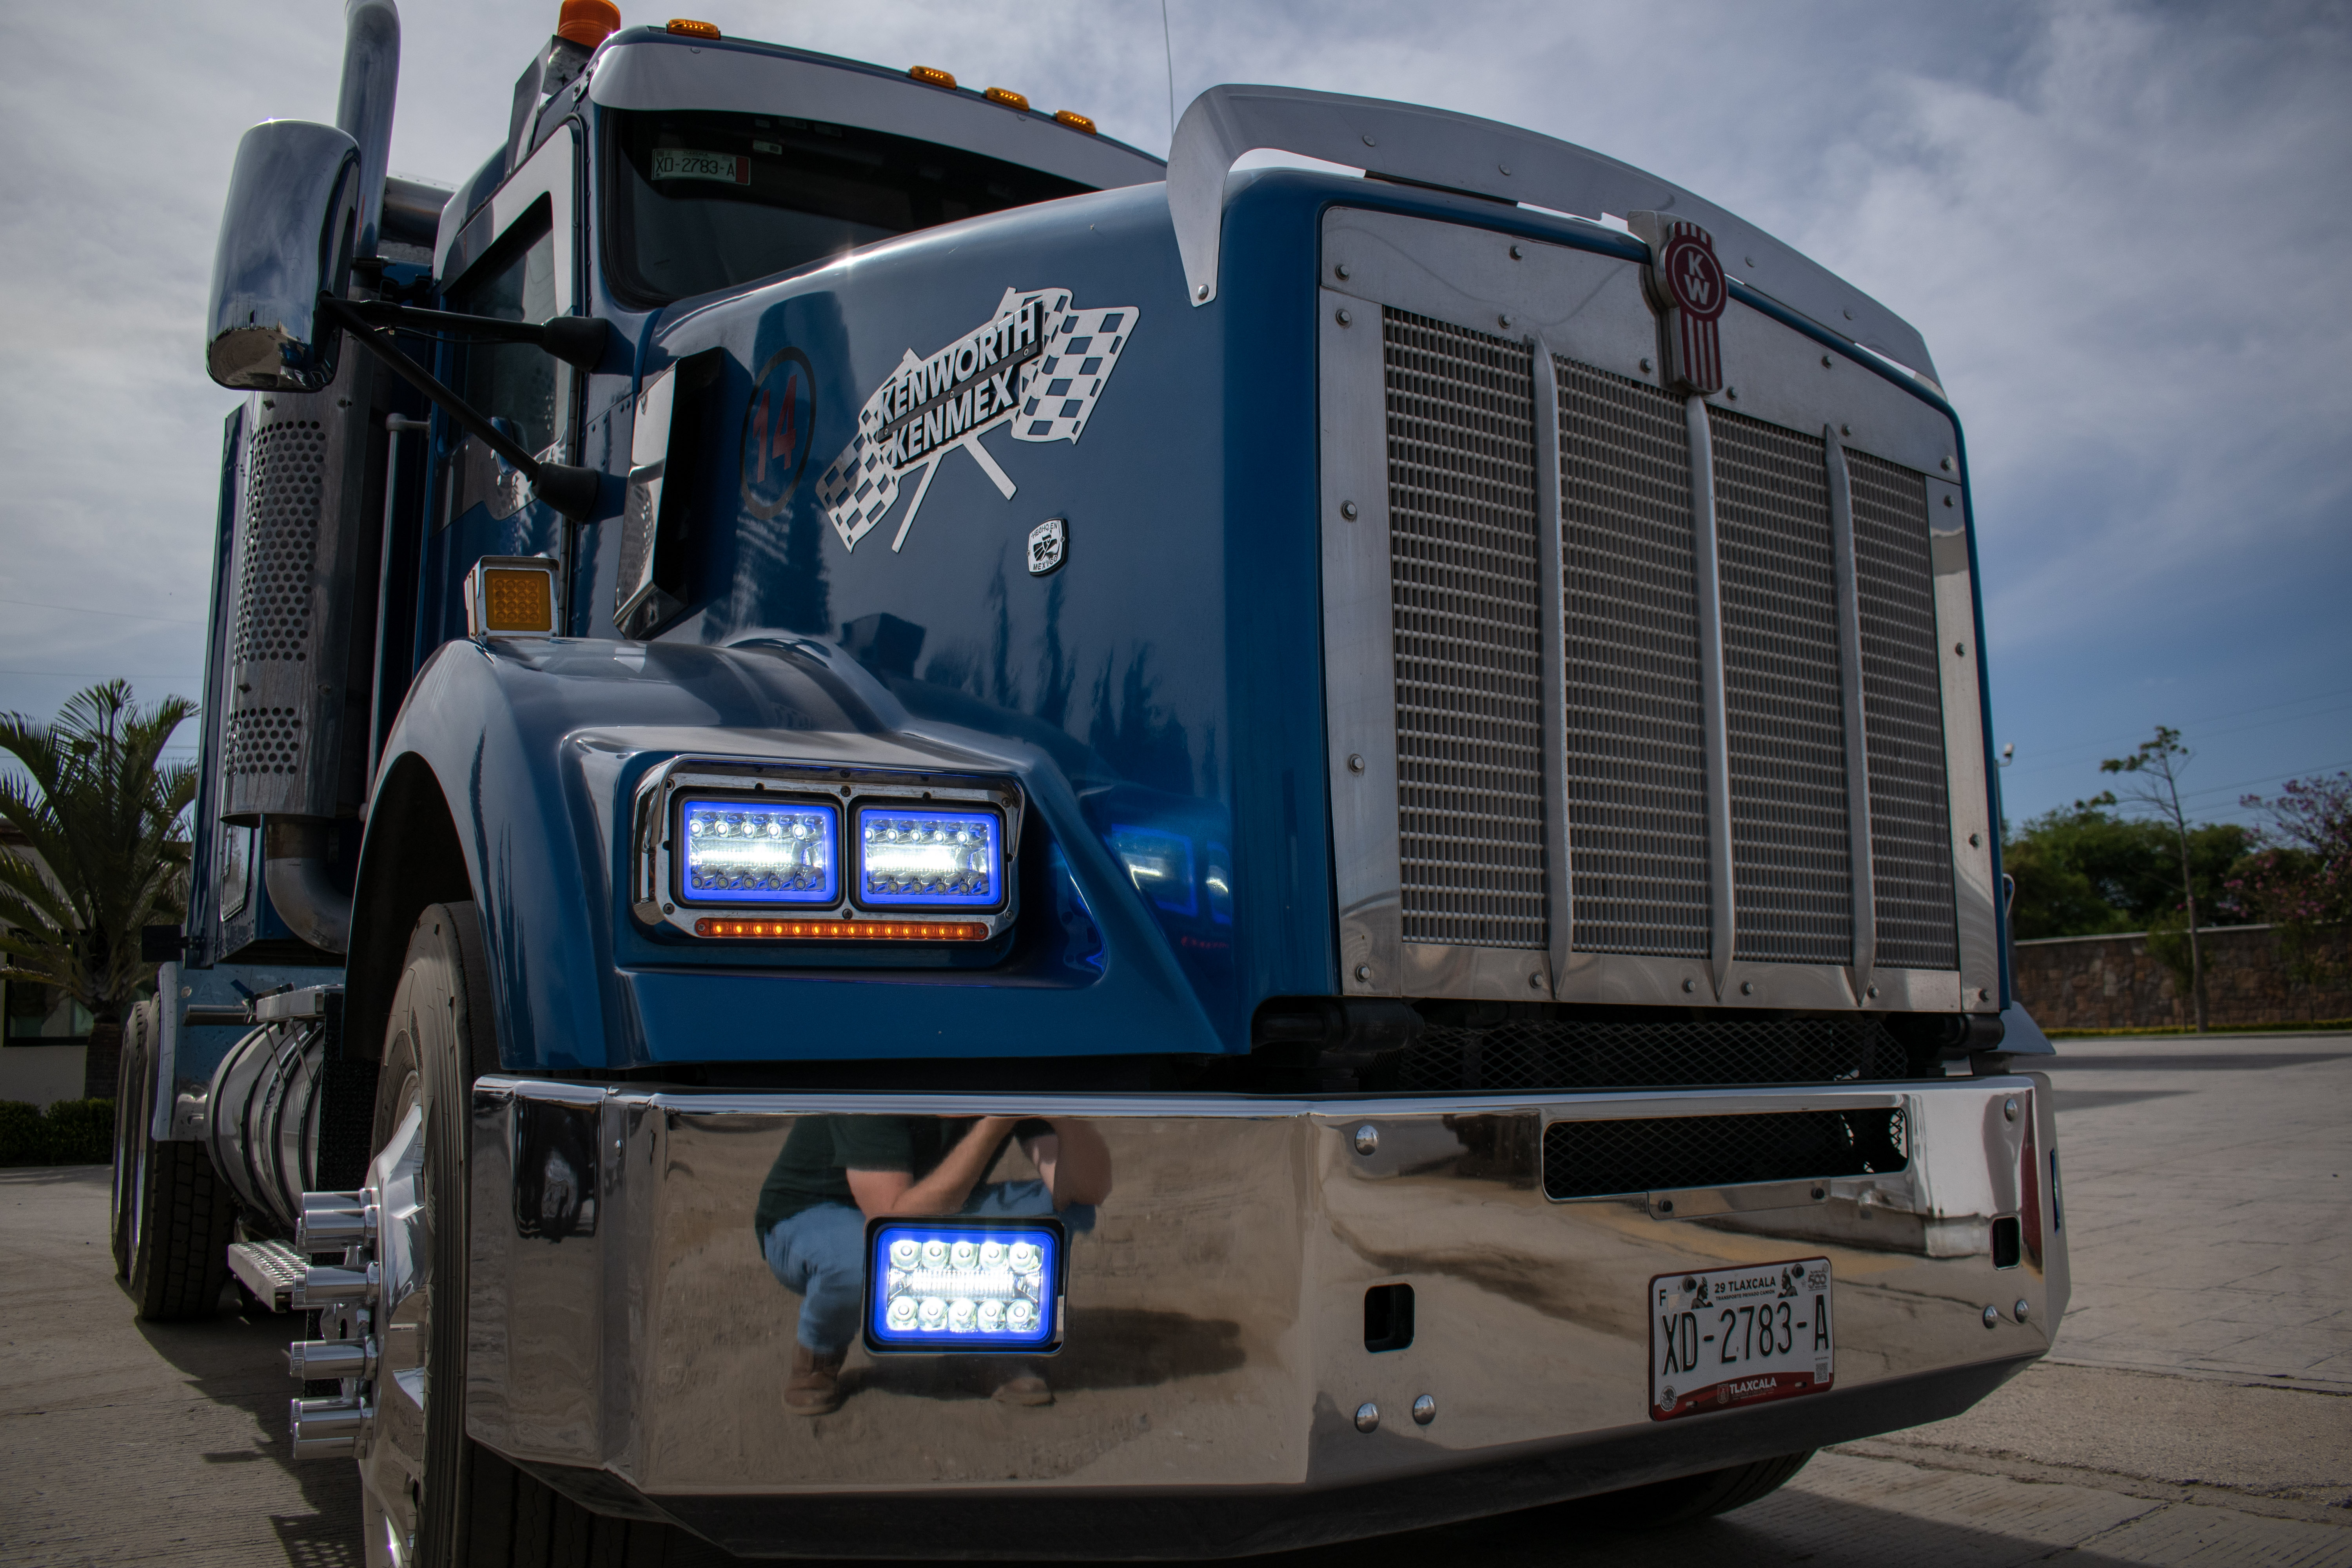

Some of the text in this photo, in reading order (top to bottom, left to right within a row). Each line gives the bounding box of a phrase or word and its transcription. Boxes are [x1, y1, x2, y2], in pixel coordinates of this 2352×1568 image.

[655, 157, 735, 177] XD-2783-A
[878, 301, 1035, 430] KENWORTH
[892, 364, 1014, 468] KENMEX
[753, 374, 797, 483] 14
[1032, 521, 1058, 539] HECHO EN
[1033, 555, 1058, 570] MEXICO
[1714, 1276, 1776, 1293] 29 TLAXCALA
[1659, 1289, 1667, 1306] F
[1661, 1294, 1829, 1376] XD-2783-A
[1729, 1377, 1777, 1394] TLAXCALA
